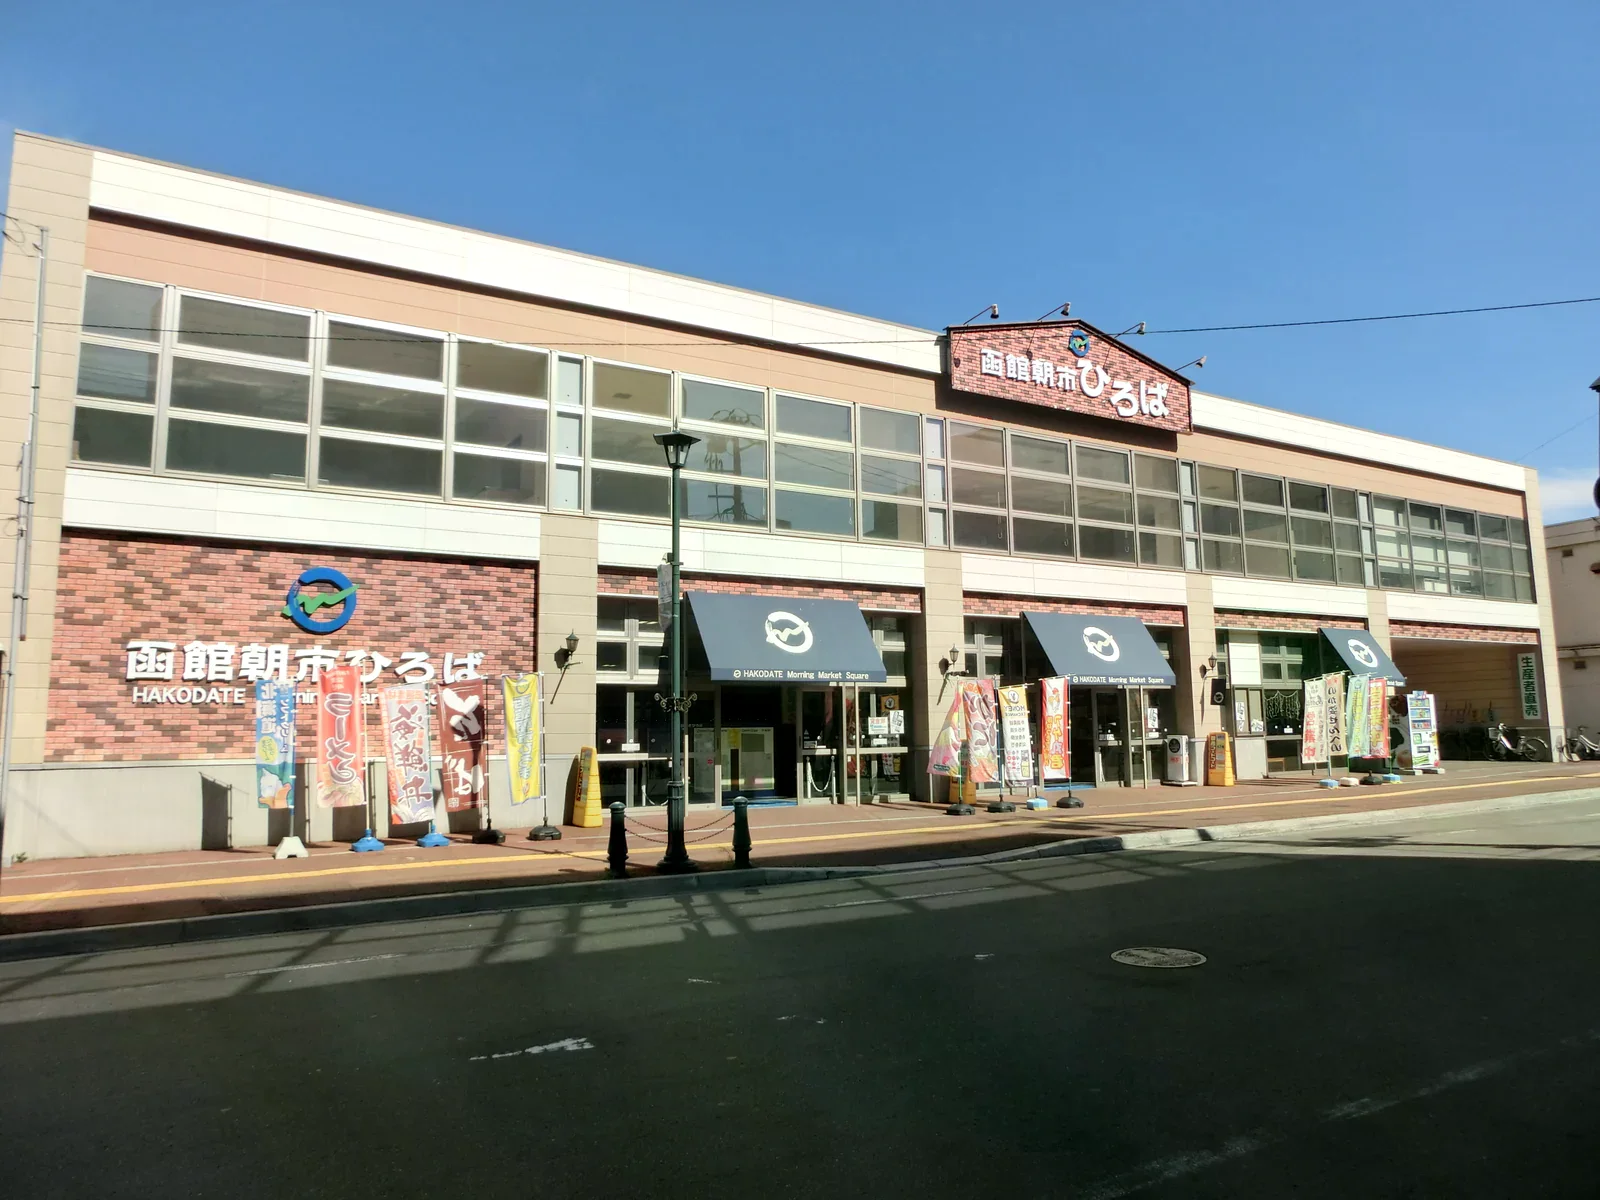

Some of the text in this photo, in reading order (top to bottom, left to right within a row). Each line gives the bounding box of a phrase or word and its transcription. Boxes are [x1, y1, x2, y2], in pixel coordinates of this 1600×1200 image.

[980, 348, 1169, 417] 函館朝市ひろば
[126, 640, 485, 684] 函館朝市ひろば
[743, 669, 869, 680] HAKODATE Morning Market Square
[132, 686, 246, 704] HAKODATE
[1108, 676, 1128, 684] Morning
[1521, 656, 1538, 716] 生産者直売
